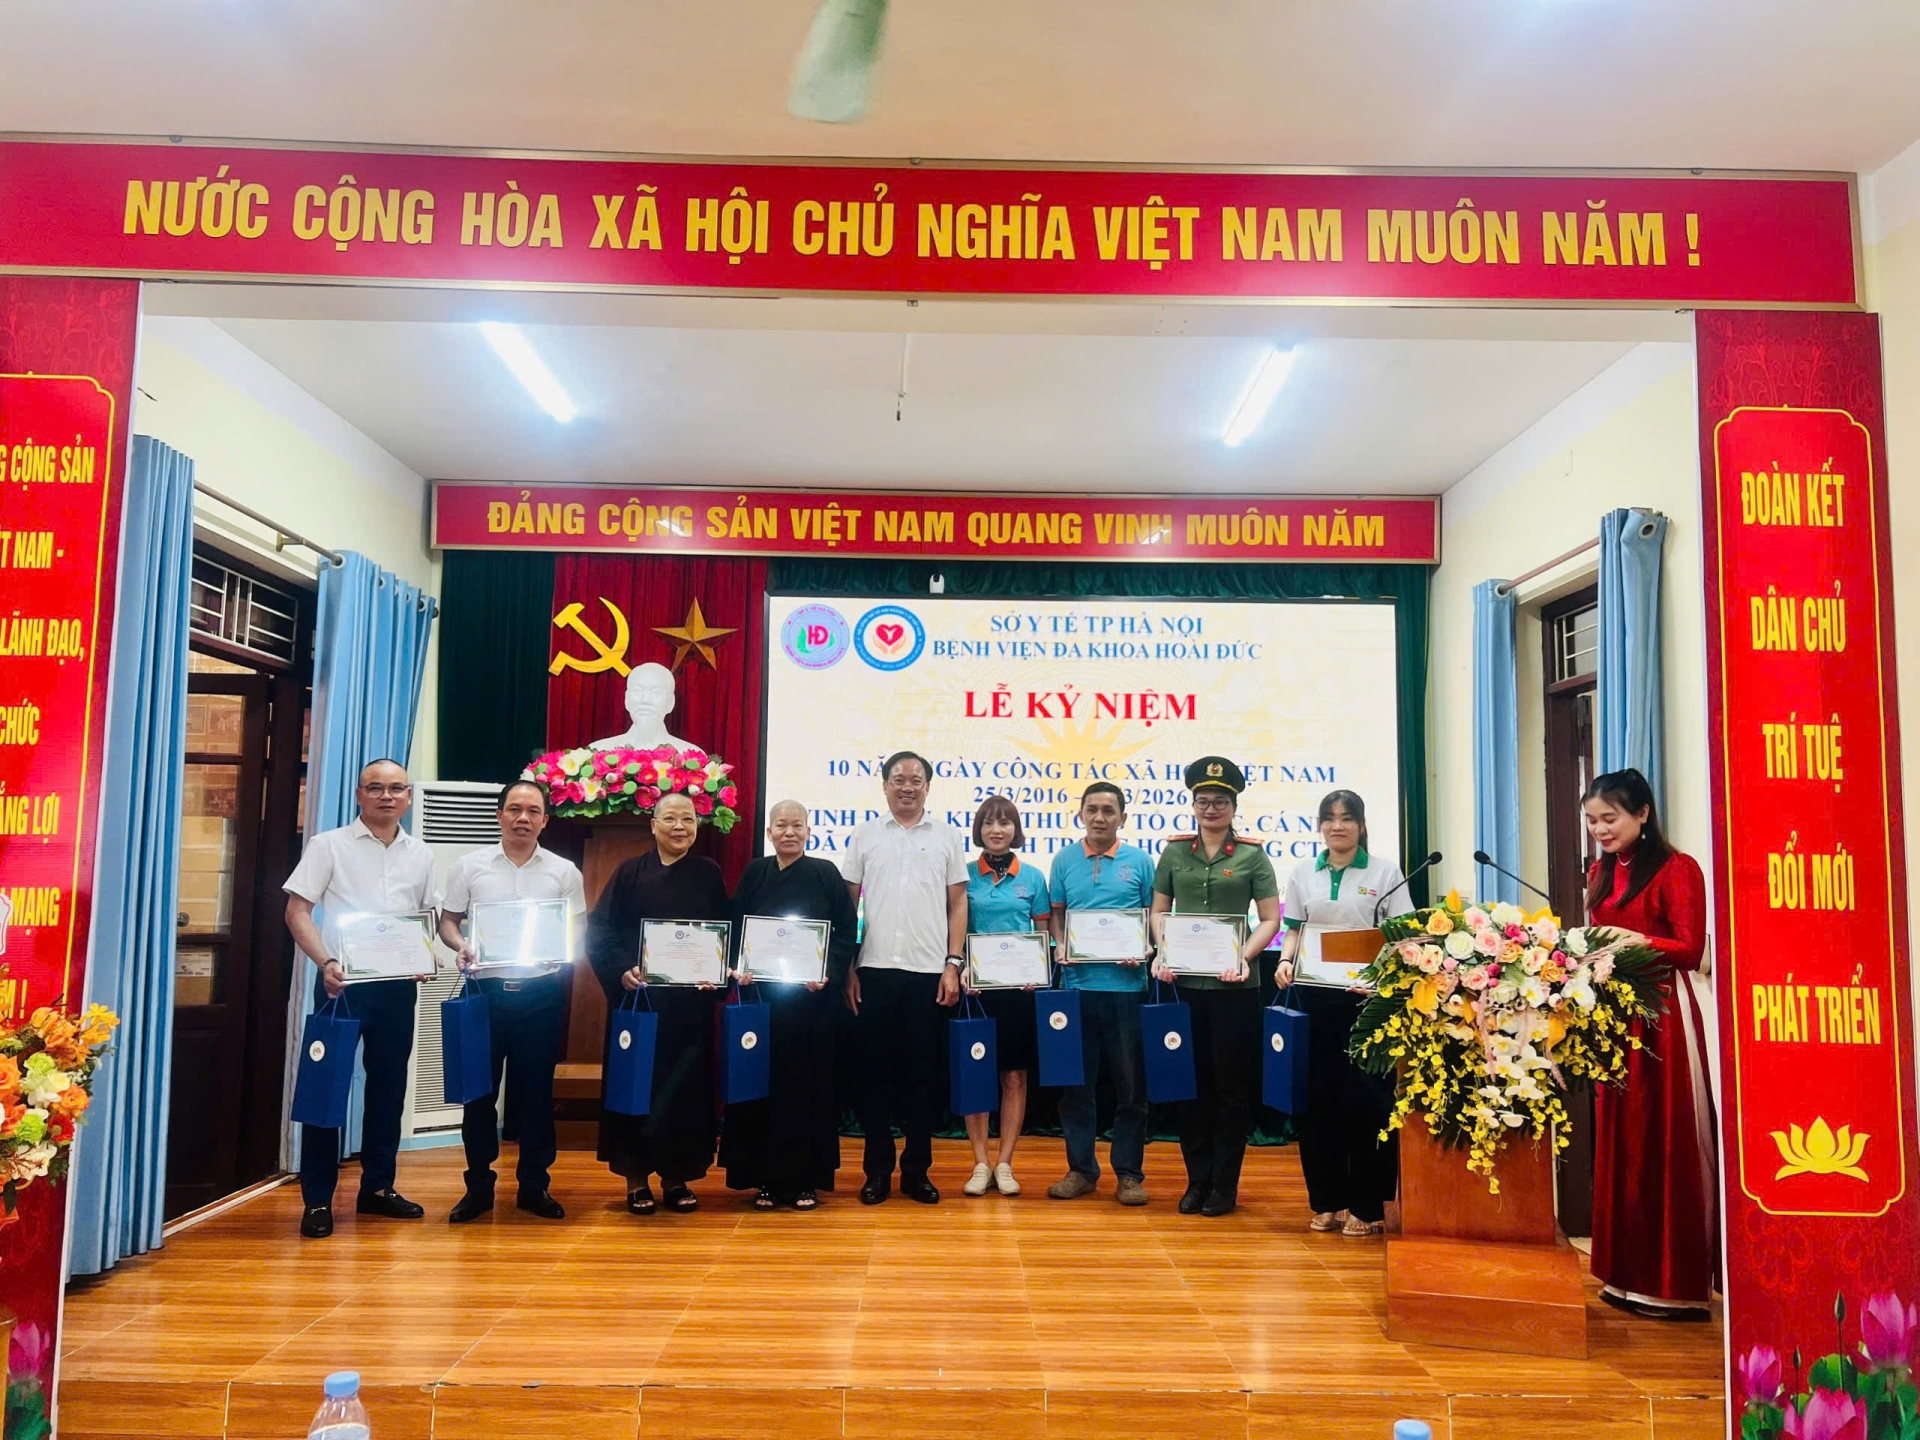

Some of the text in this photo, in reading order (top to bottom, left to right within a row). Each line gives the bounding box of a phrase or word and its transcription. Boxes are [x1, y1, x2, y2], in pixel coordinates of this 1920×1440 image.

[124, 165, 1700, 270] NƯỚC CỘNG HÒA XÃ HỘI CHỦ NGHĨA VIỆT NAM MUÔN NĂM !
[10, 437, 56, 491] CỘNG
[60, 433, 95, 483] SẢN
[487, 490, 1384, 547] ĐẢNG CỘNG SẢN VIỆT NAM QUANG VINH MUÔN NĂM
[1741, 457, 1845, 527] ĐOÀN KẾT
[13, 531, 54, 569] NAM
[0, 610, 84, 665] LÃNH ĐẠO,
[990, 610, 1203, 638] SỞ Y TẾ TP HÀ NỘI
[1750, 579, 1846, 653] DÂN CHỦ
[933, 639, 990, 659] BỆNH
[997, 640, 1046, 660] VIỆN
[1053, 641, 1082, 658] ĐA
[1088, 642, 1150, 658] KHOA
[1155, 639, 1209, 658] HOÀI
[1217, 639, 1262, 659] ĐỨC
[964, 683, 1198, 727] LỄ KỶ NIỆM
[828, 760, 850, 776] 10
[857, 755, 886, 776] NĂ
[931, 756, 986, 778] GÀY
[993, 756, 1062, 779] CÔNG
[1068, 758, 1117, 780] TÁC
[1125, 759, 1157, 780] XÃ
[1280, 766, 1336, 783] NAM
[1762, 712, 1844, 793] TRÍ TUỆ
[32, 792, 60, 844] LỢI
[1257, 811, 1290, 832] CÁ
[1767, 829, 1855, 911] ĐỔI MỚI
[8, 887, 60, 936] MẠNG
[1752, 962, 1881, 1045] PHÁT TRIỂN
